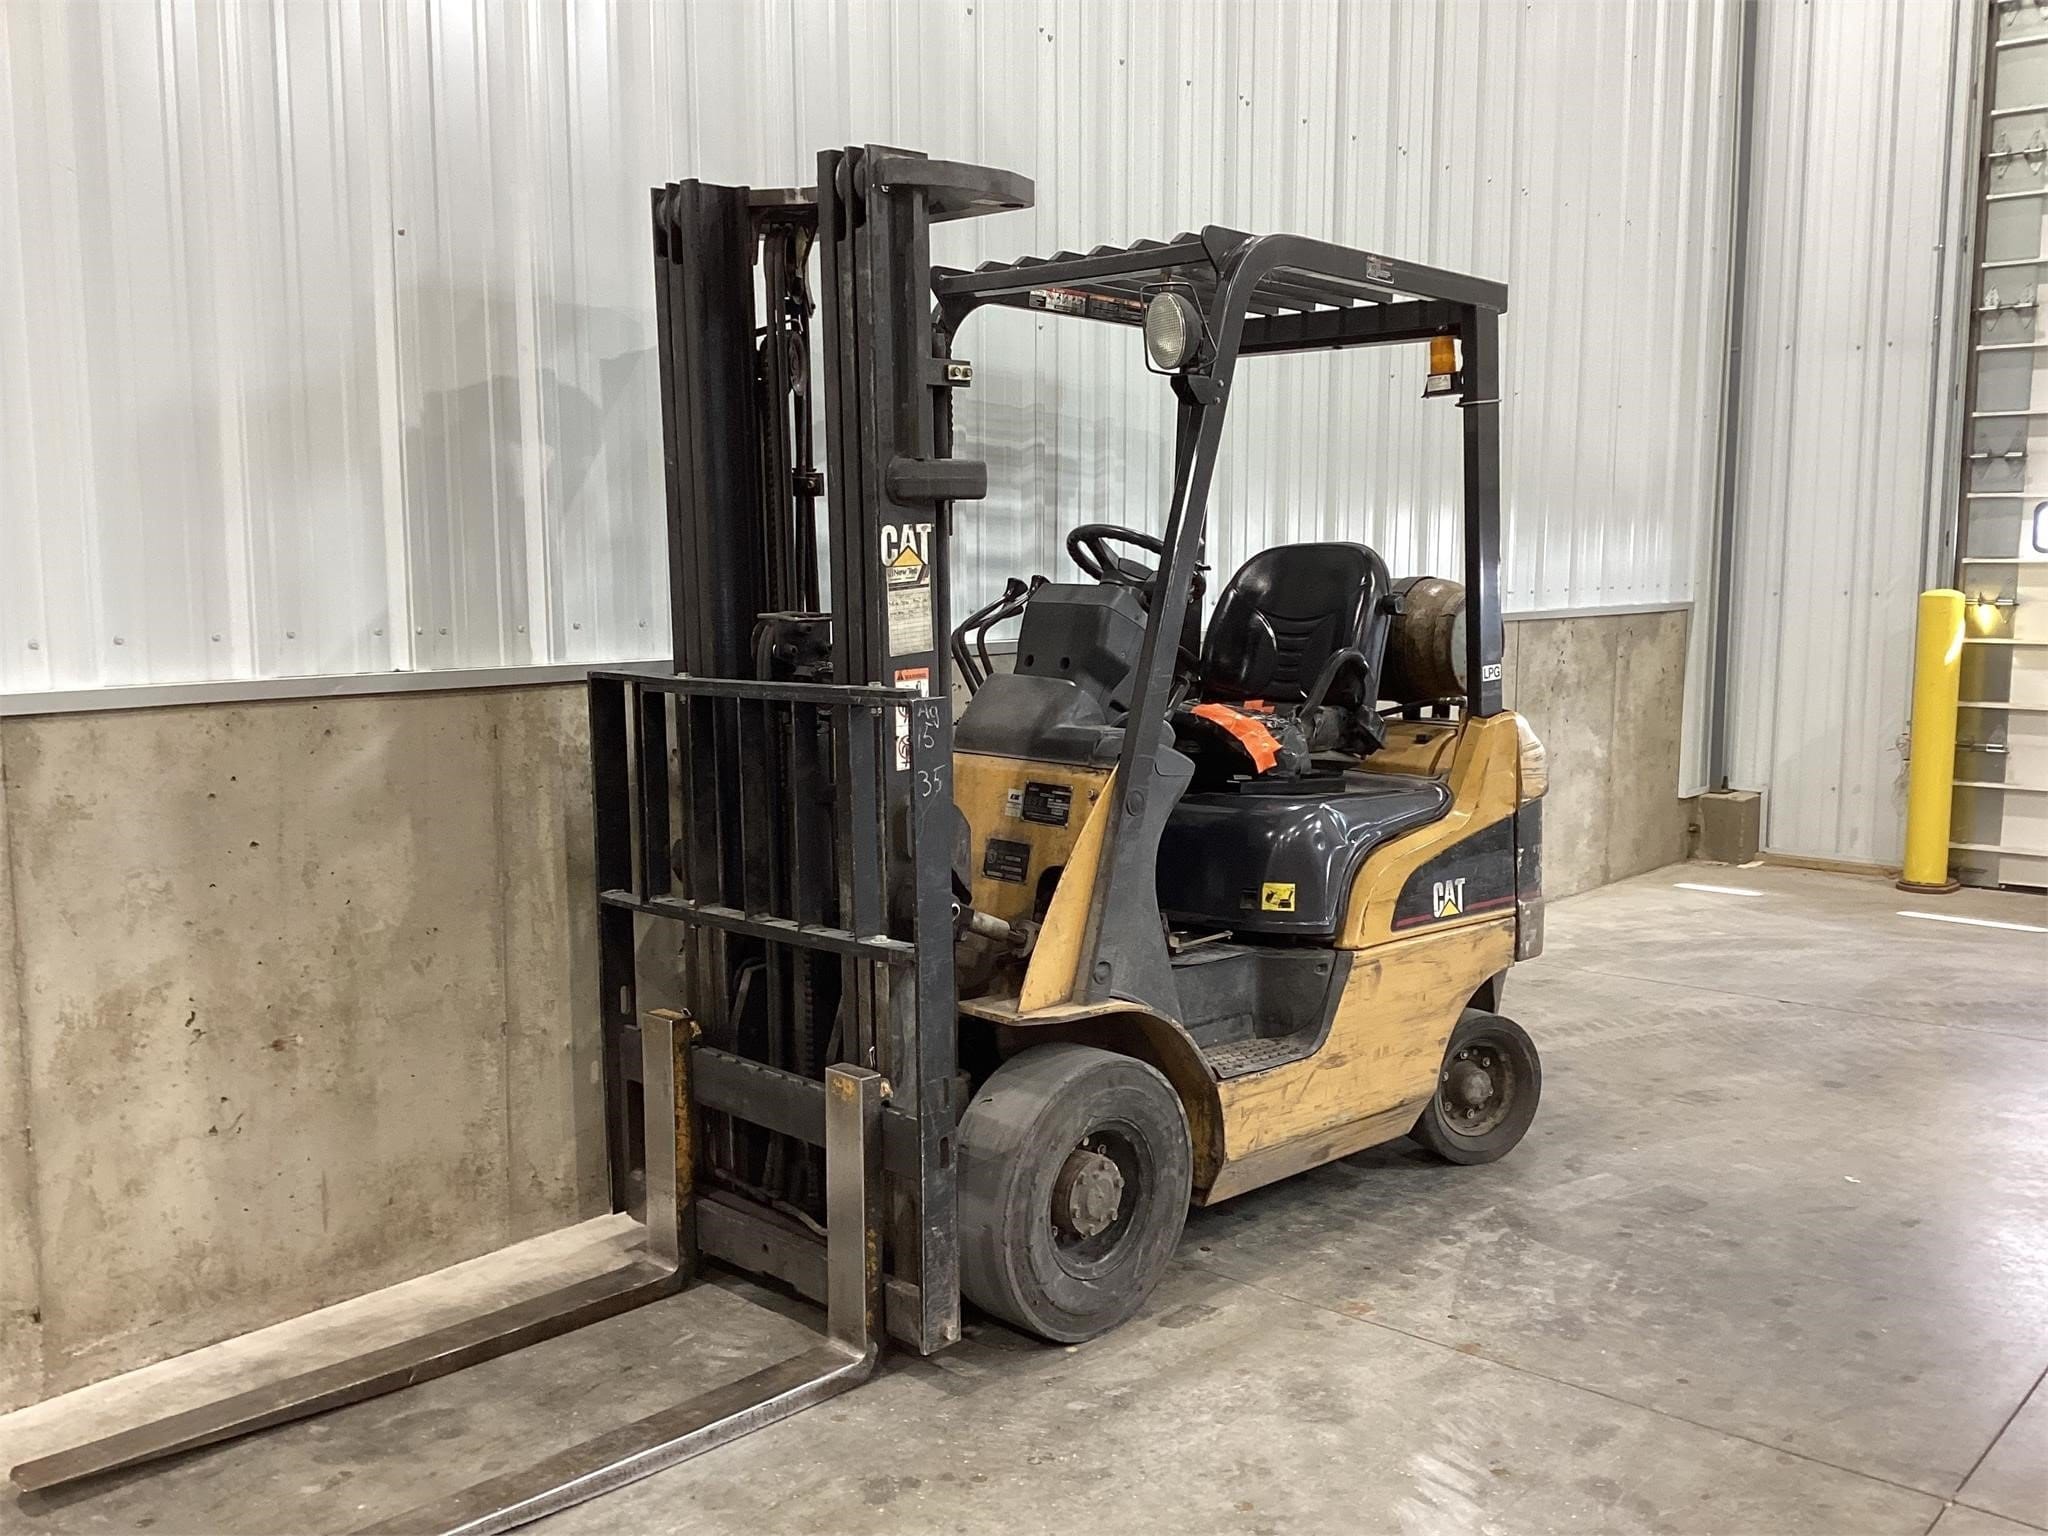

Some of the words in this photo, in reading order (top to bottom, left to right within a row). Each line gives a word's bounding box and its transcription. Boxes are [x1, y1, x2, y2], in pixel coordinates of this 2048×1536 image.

[881, 523, 931, 567] CAT
[1484, 666, 1500, 679] LPG
[918, 764, 946, 797] 35
[1433, 877, 1465, 918] CAT
